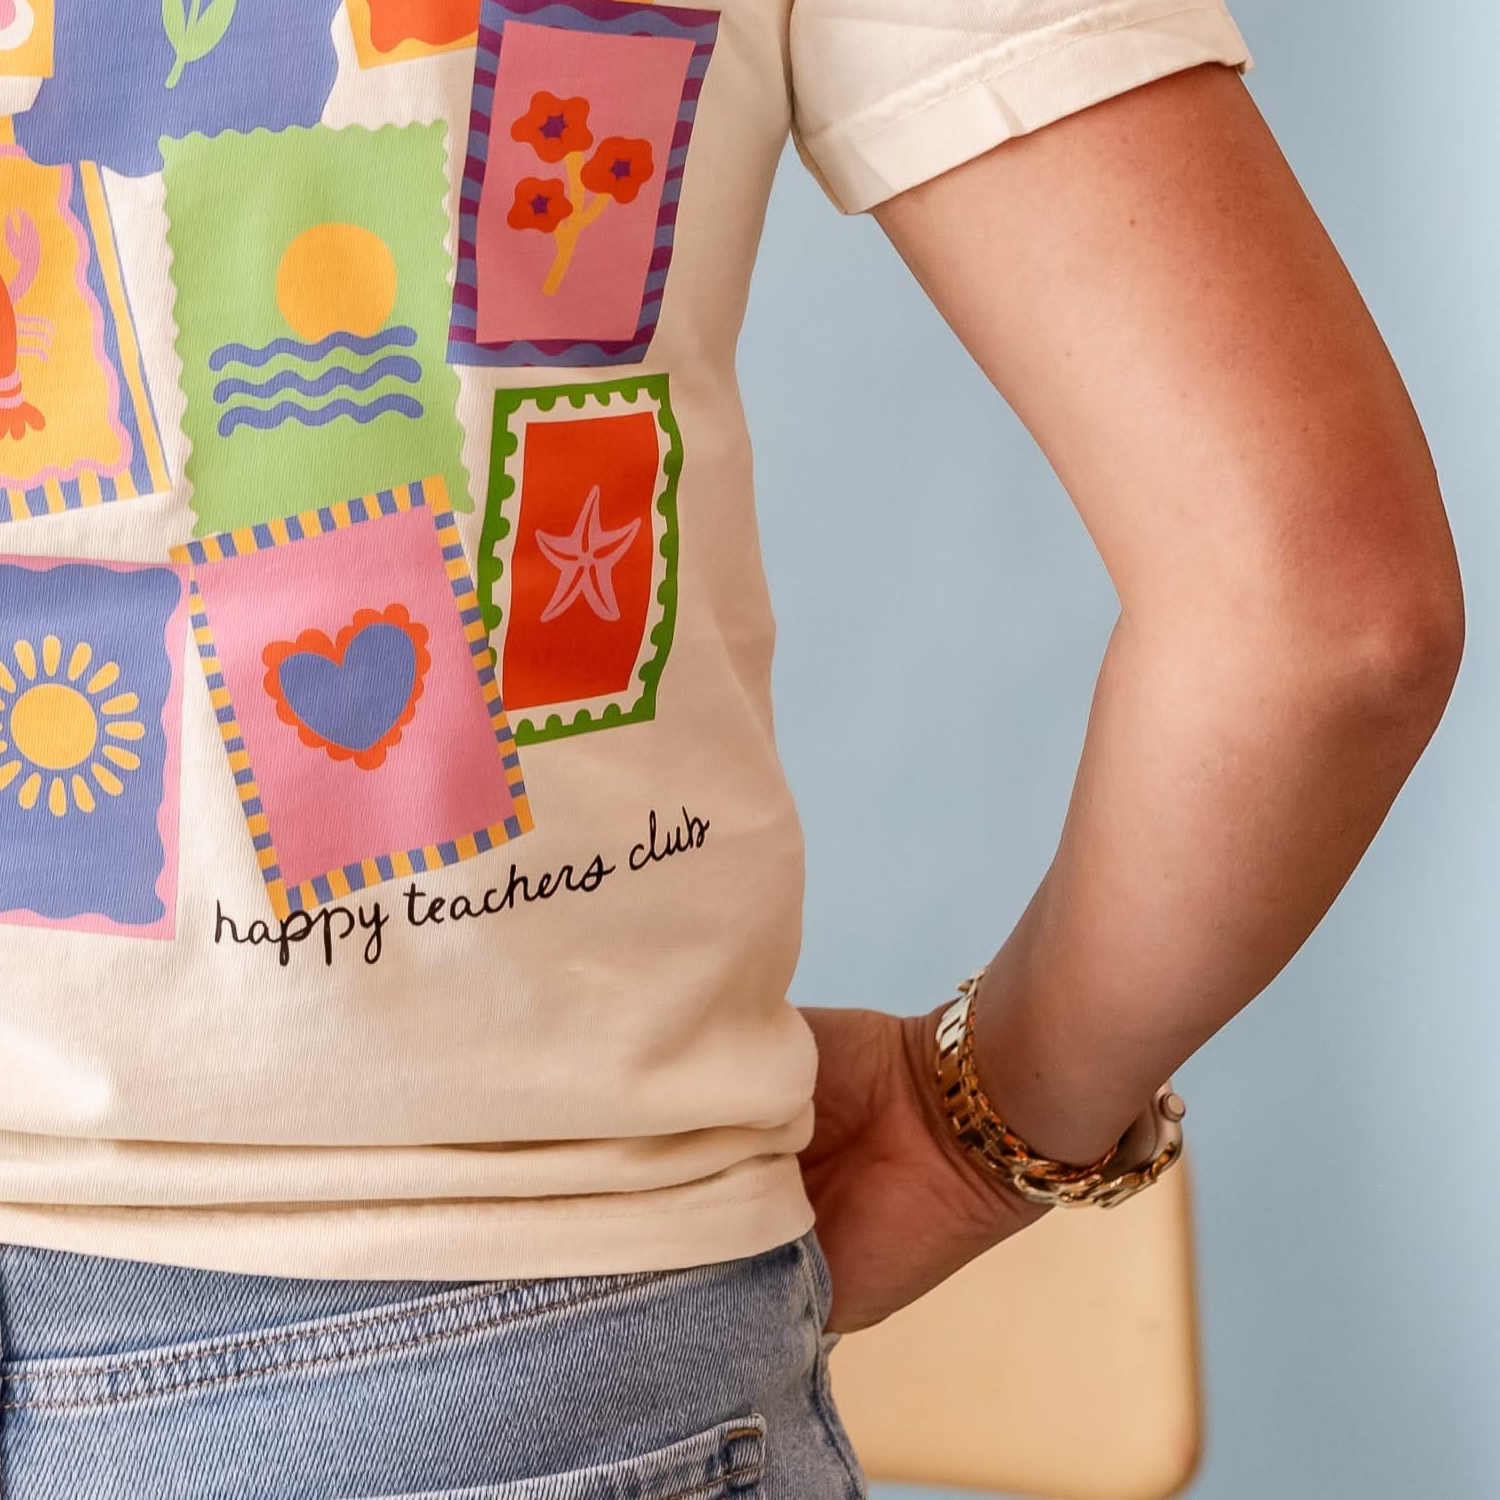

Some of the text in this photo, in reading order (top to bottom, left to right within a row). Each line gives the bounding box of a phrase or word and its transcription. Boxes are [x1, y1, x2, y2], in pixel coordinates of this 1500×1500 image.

[214, 806, 711, 967] happy teachers club
